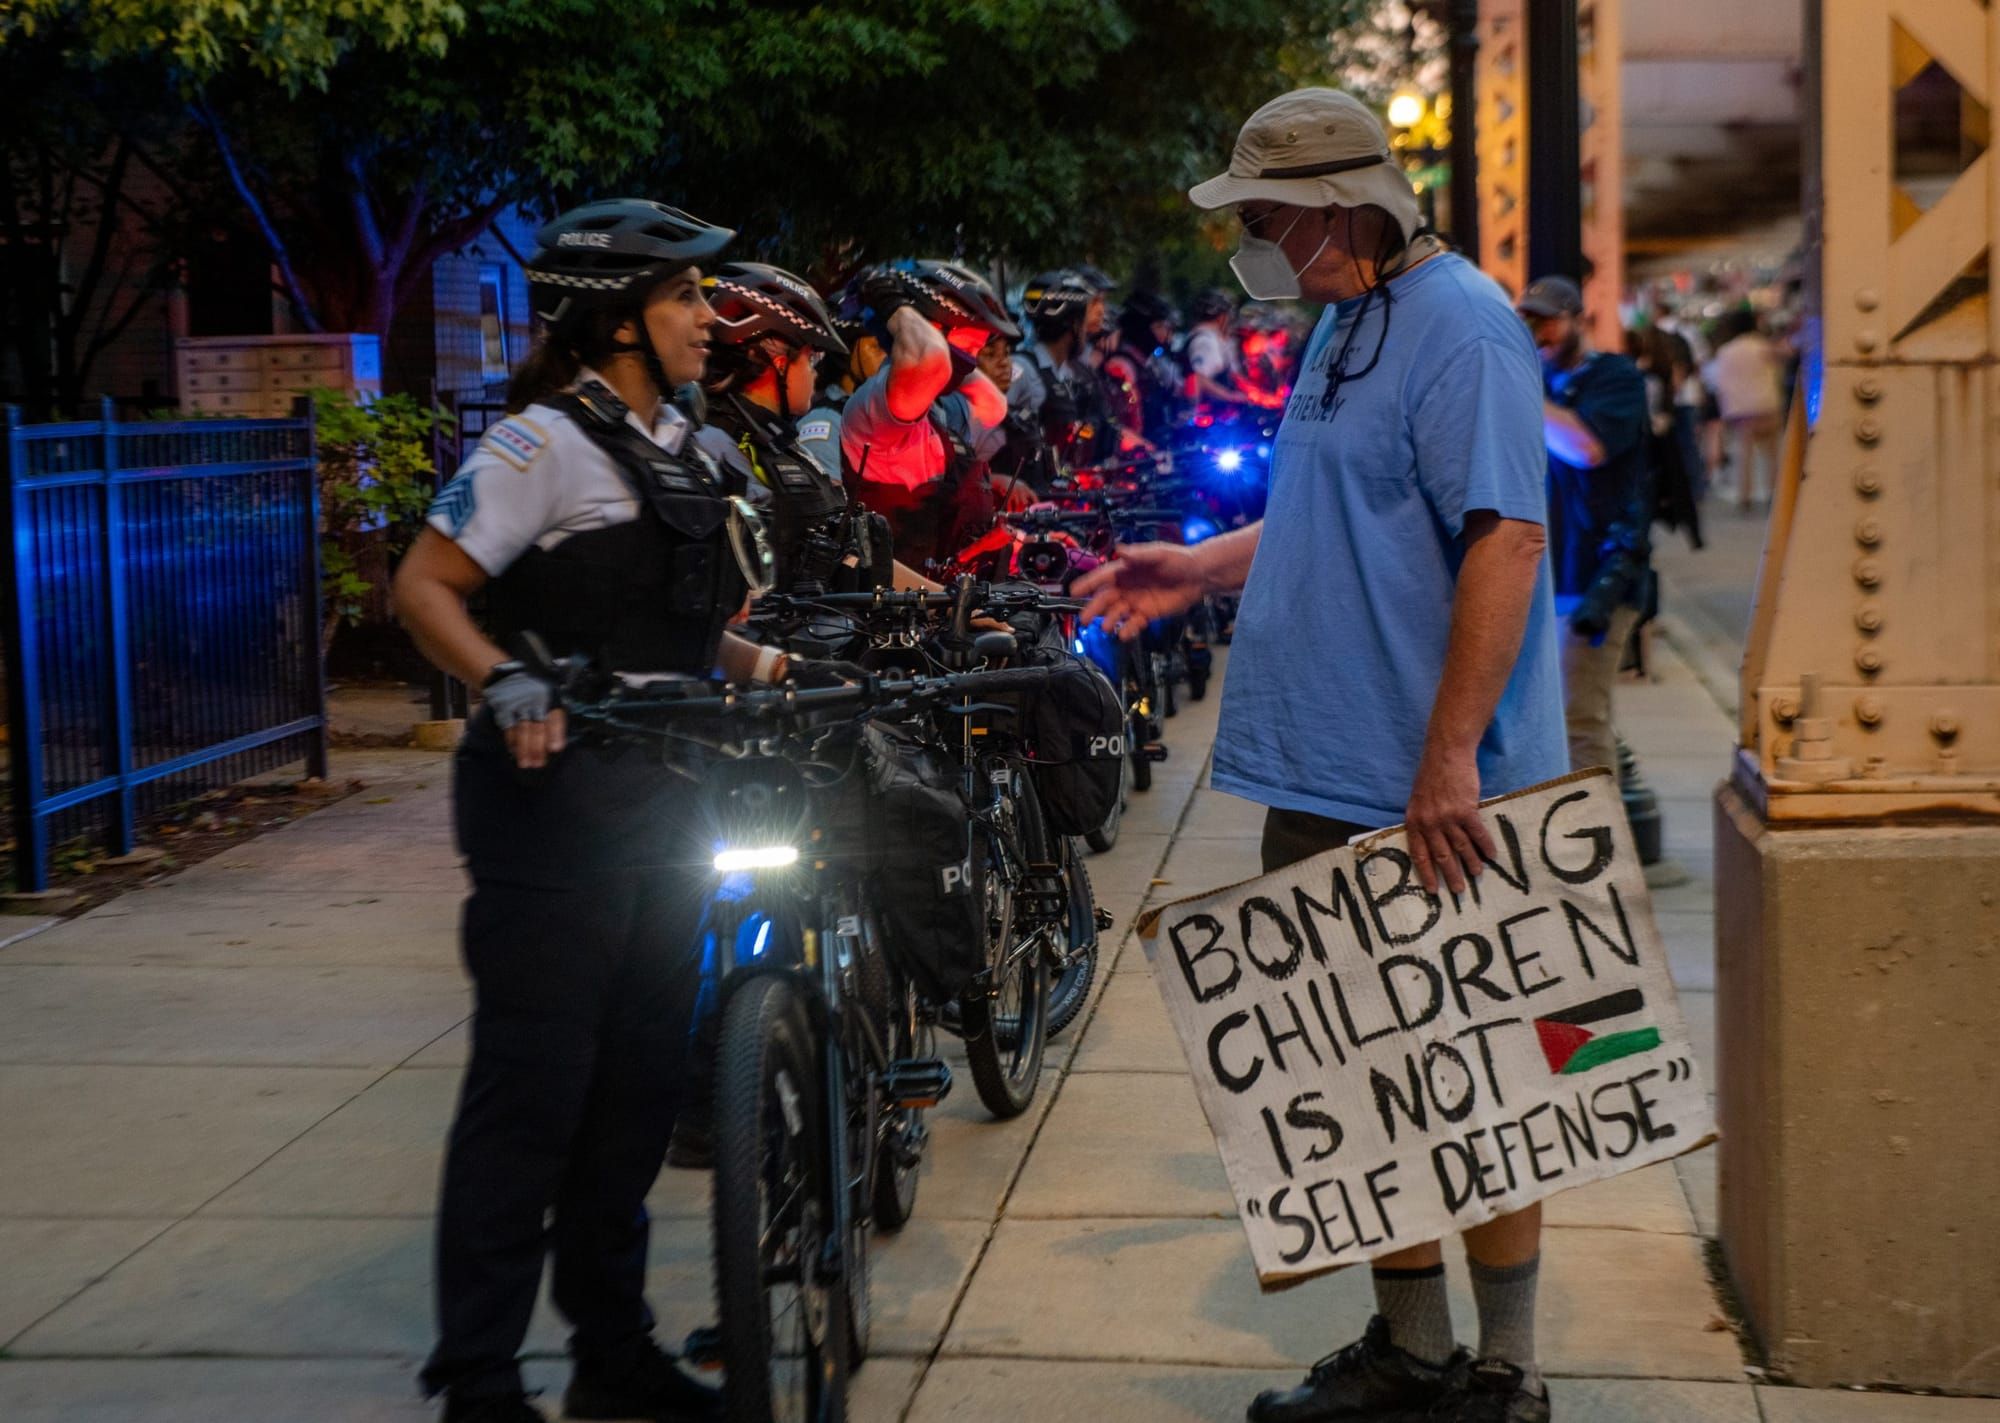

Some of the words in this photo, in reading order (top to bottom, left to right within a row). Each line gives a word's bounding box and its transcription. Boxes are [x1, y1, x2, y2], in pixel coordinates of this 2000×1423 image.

[556, 232, 612, 249] POLICE
[775, 275, 809, 299] POLICE
[935, 267, 965, 290] POLICE
[1169, 790, 1614, 1003] BOMBNG
[1207, 882, 1639, 1094] CHILDREN
[1261, 1091, 1344, 1179] IS
[1369, 1017, 1523, 1143] NOT
